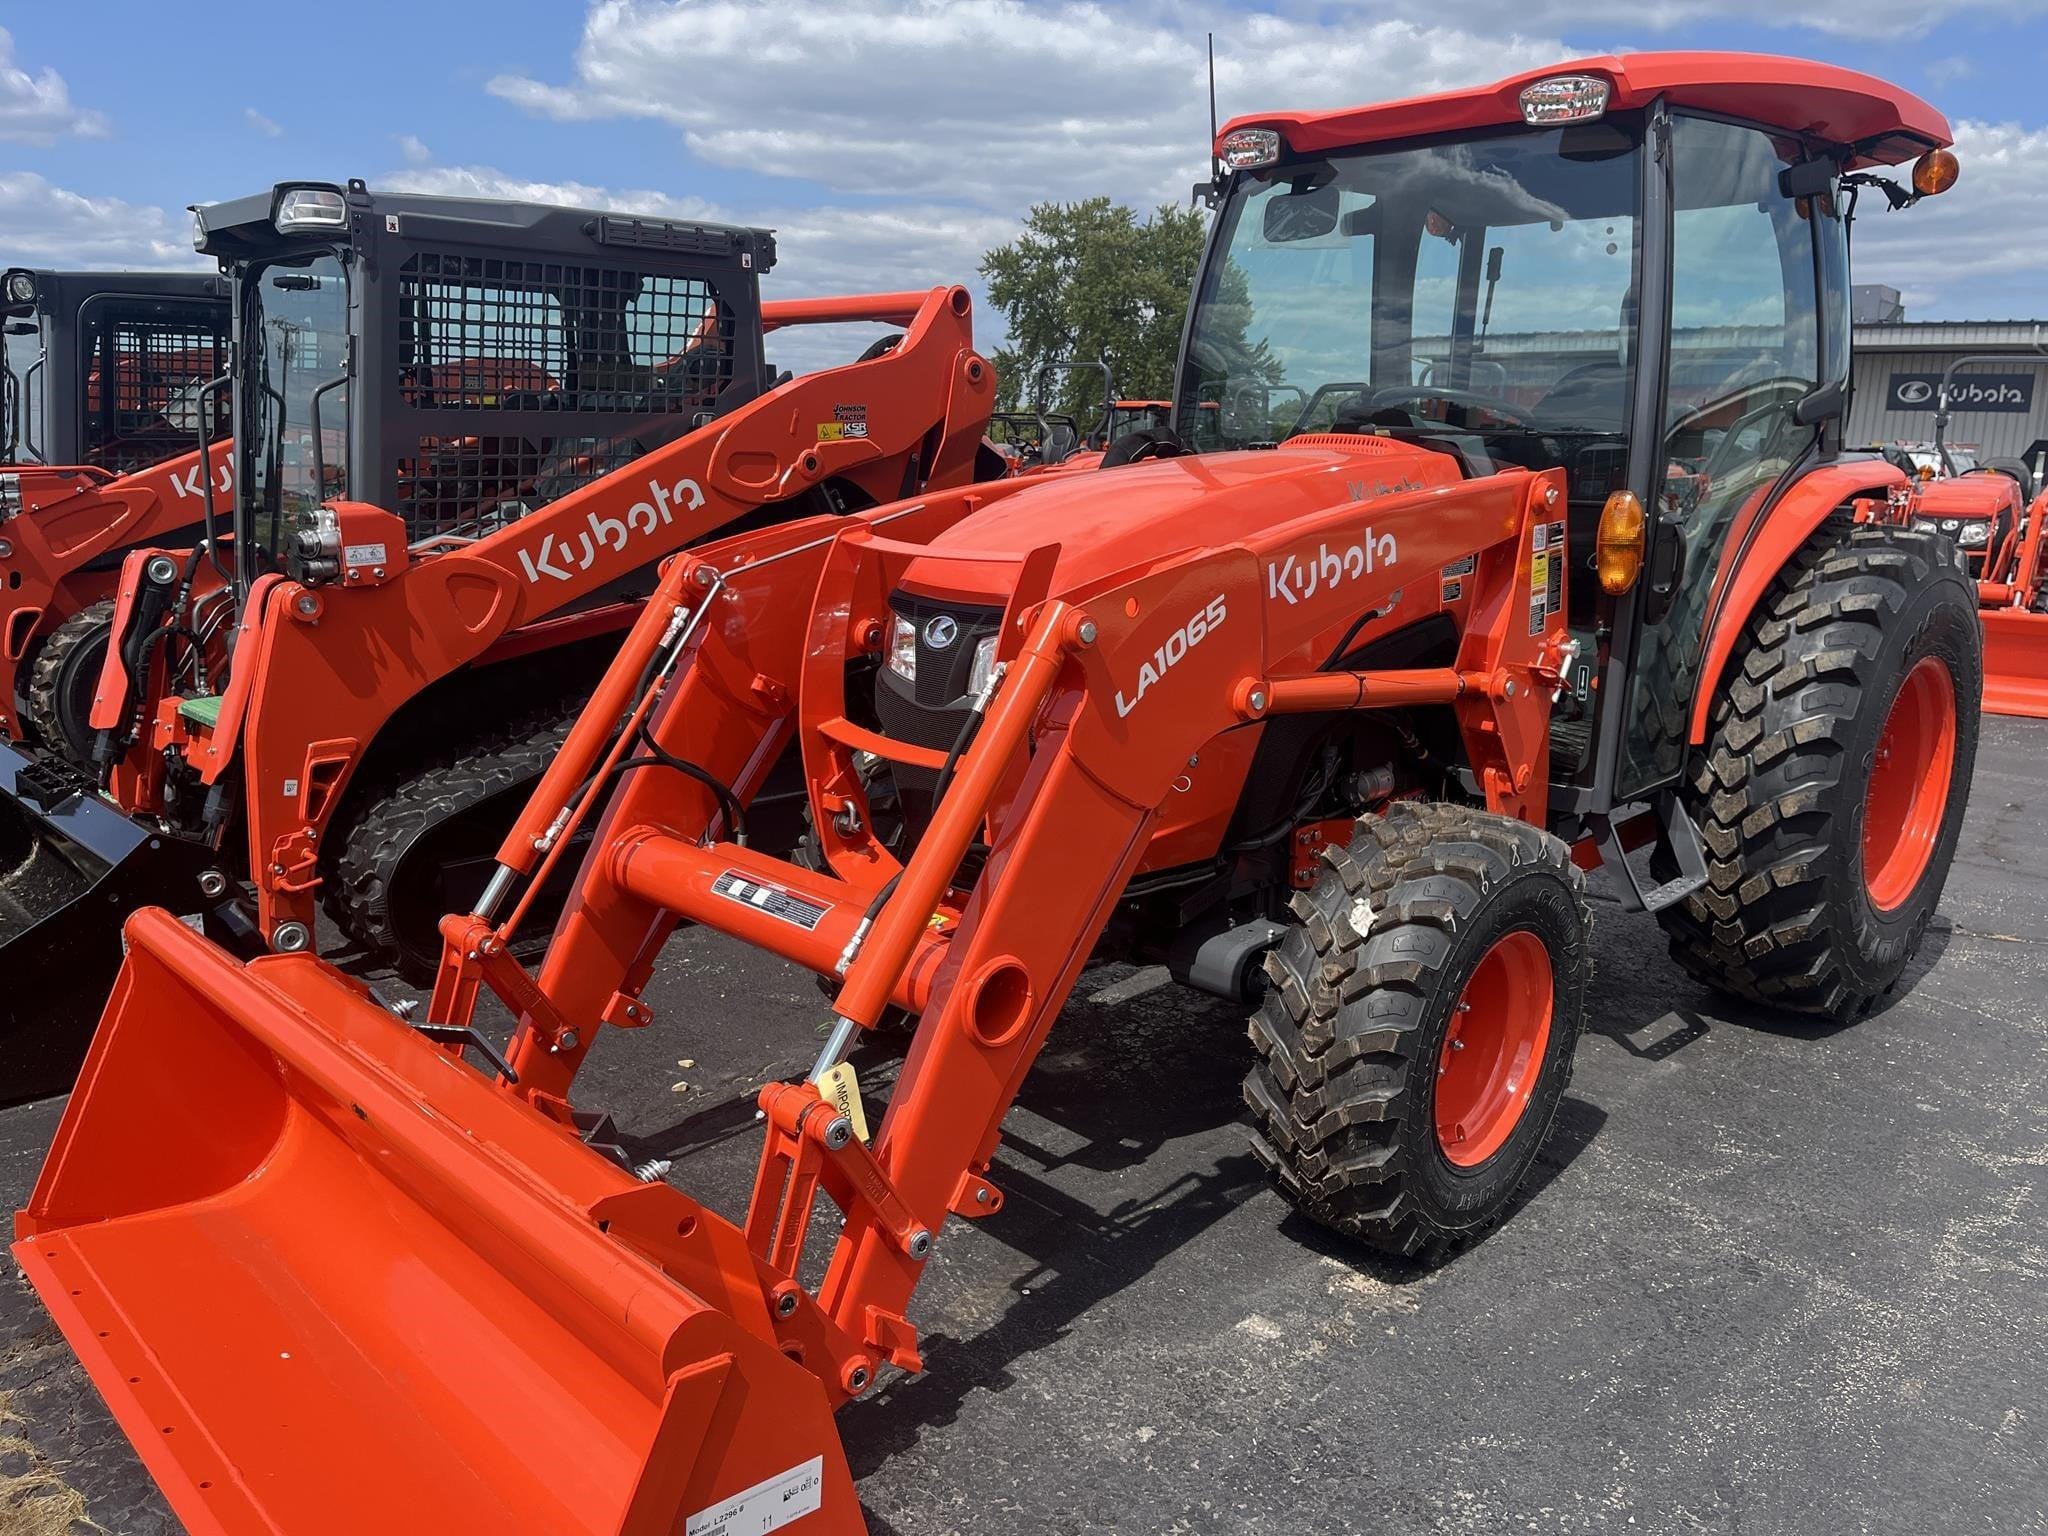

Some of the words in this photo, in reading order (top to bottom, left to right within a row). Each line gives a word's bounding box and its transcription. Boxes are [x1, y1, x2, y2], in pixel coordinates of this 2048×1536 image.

[833, 404, 867, 413] JOHNSON
[834, 412, 866, 422] TRACTOR
[843, 422, 867, 432] KSR
[517, 478, 706, 583] Kubota
[1268, 526, 1397, 605] Kubota
[1114, 593, 1227, 718] LA1065
